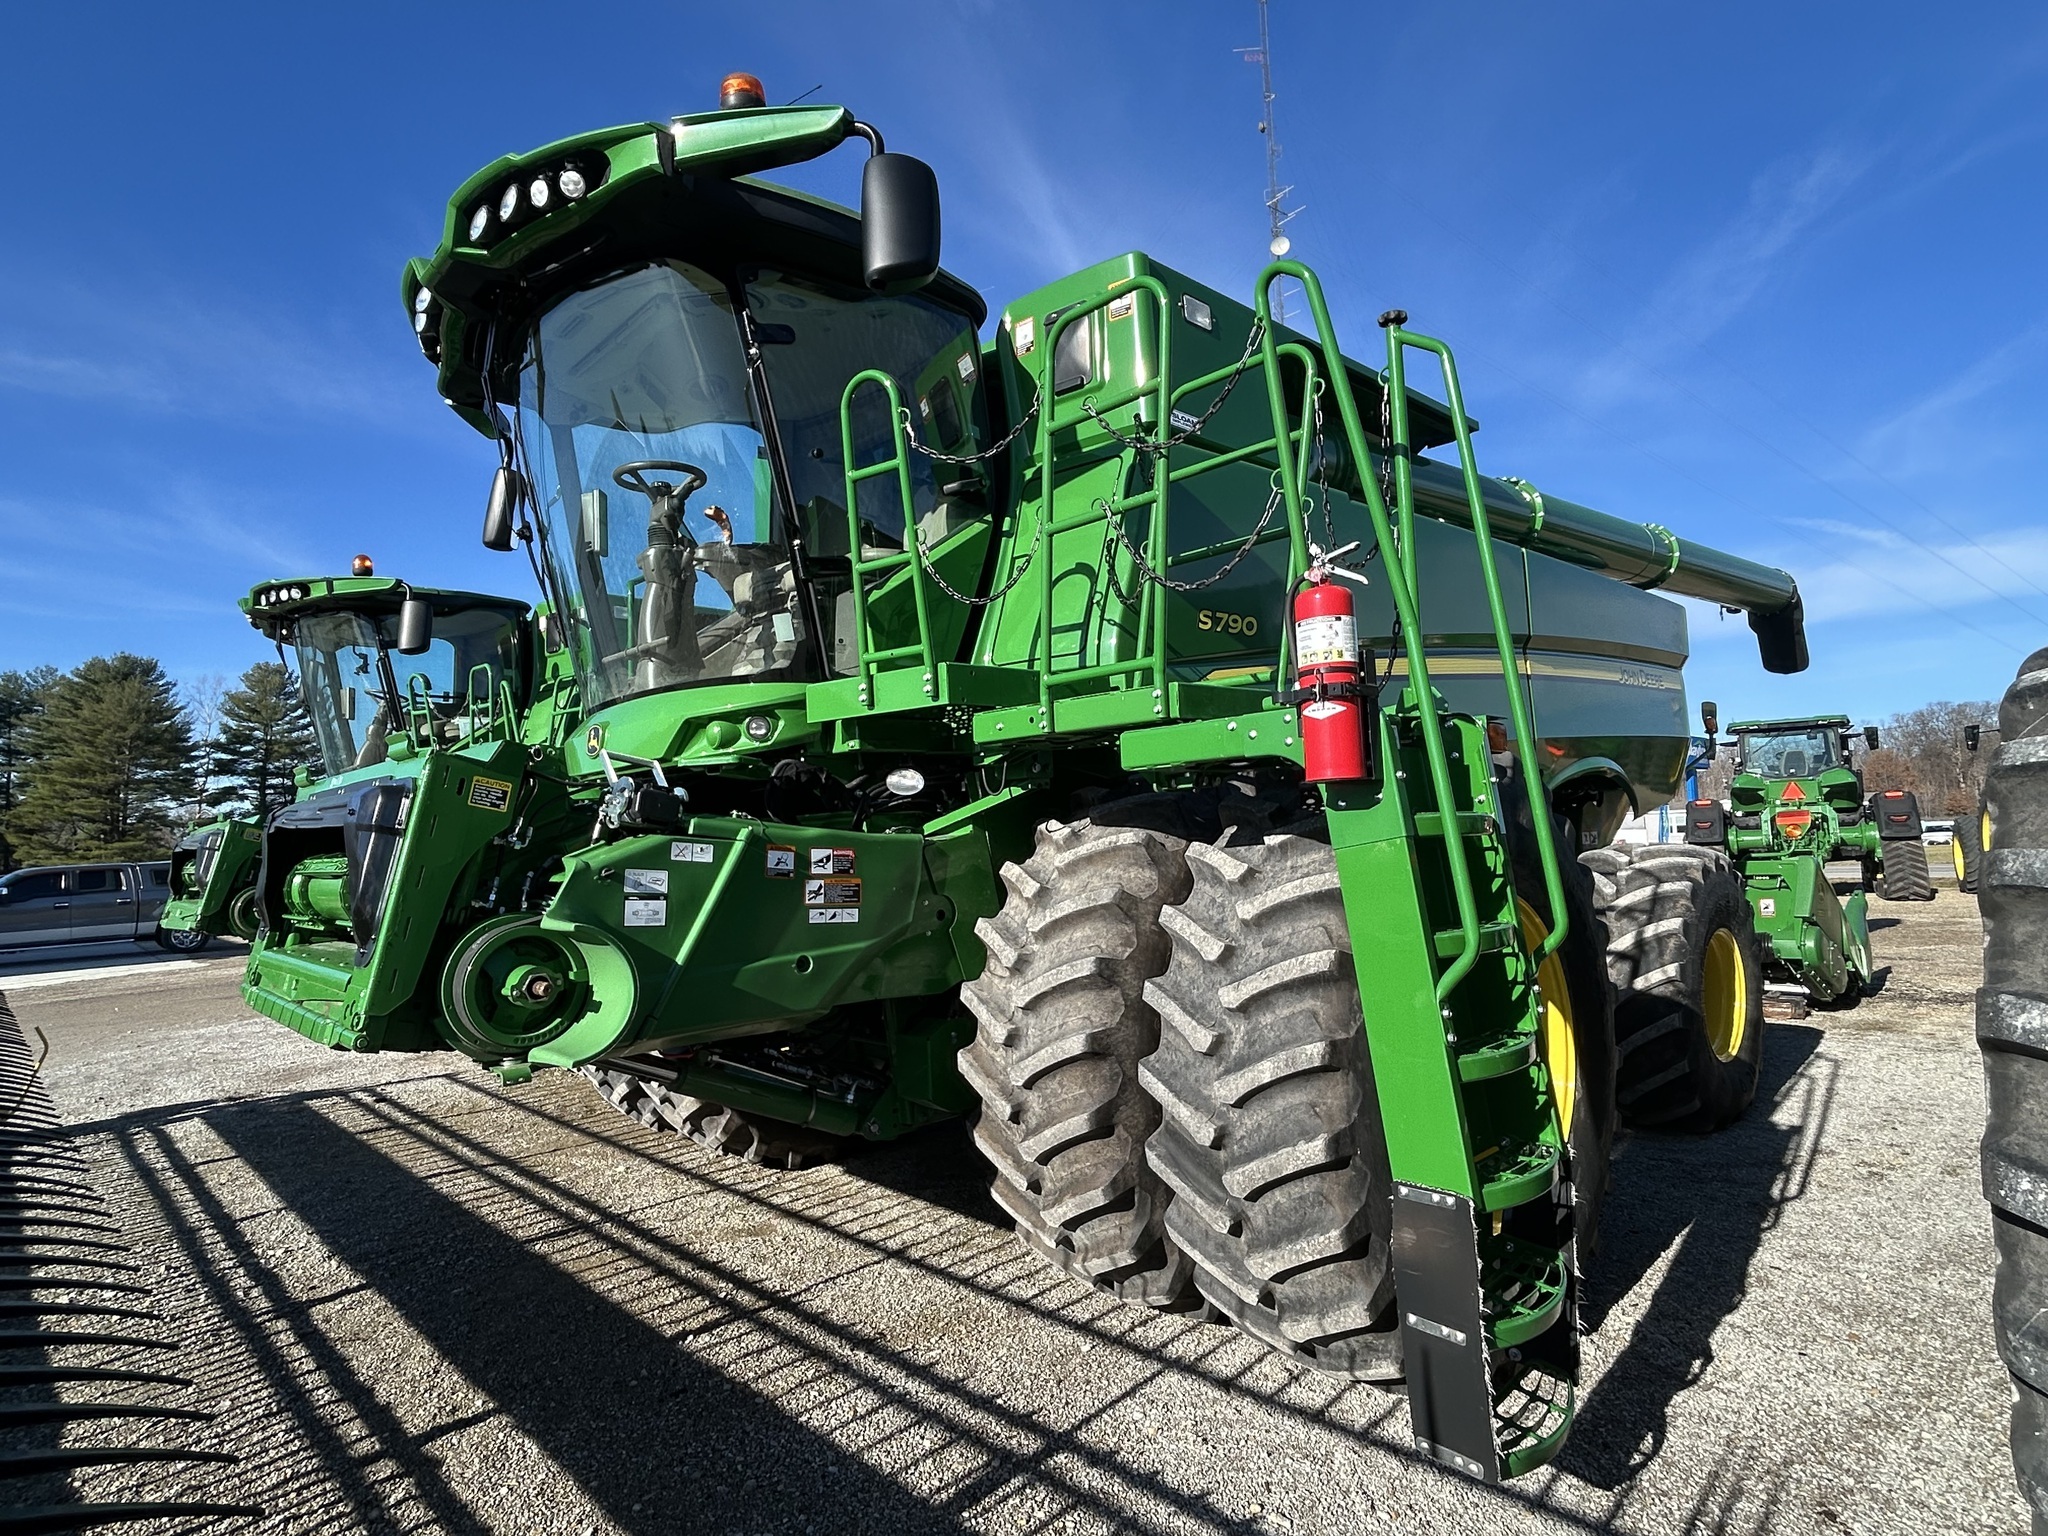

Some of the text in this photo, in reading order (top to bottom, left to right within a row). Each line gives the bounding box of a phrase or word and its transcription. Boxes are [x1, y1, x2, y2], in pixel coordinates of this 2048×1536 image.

[1198, 609, 1258, 636] S790
[1619, 666, 1666, 689] JOHN DEERE
[480, 778, 510, 790] CAUTION
